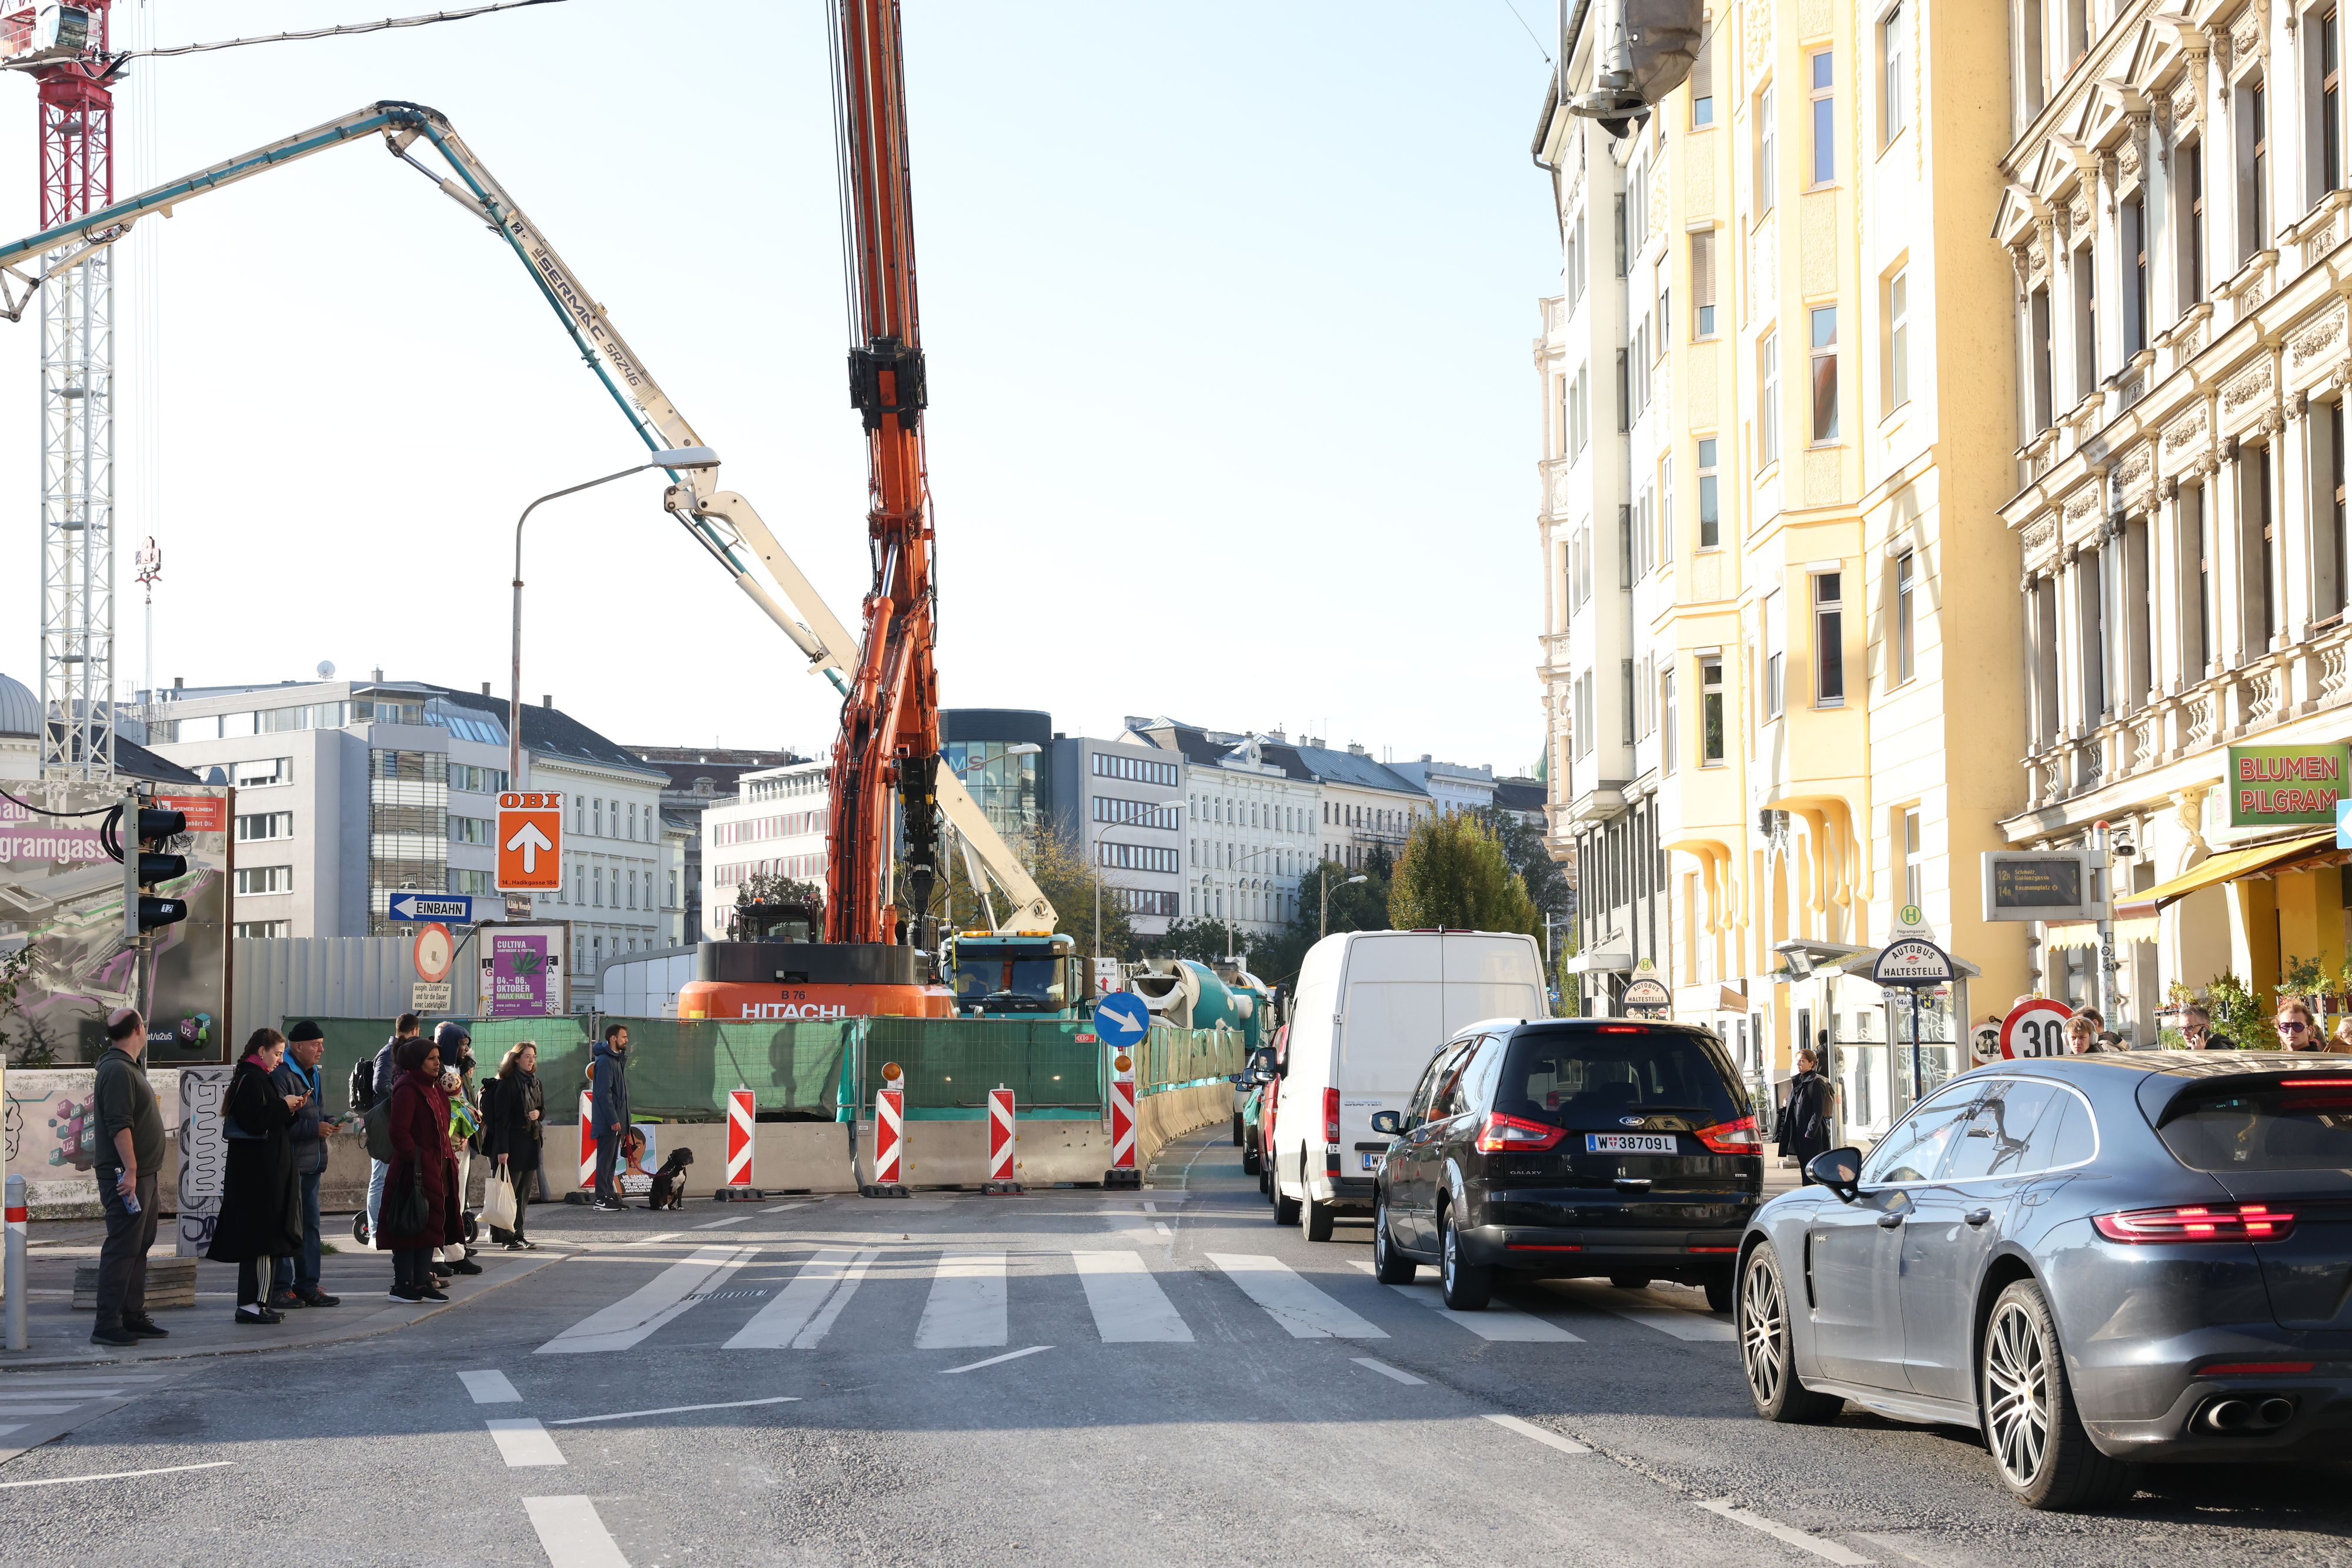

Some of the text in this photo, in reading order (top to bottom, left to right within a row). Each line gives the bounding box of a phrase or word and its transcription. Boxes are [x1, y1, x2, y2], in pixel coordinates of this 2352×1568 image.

[538, 257, 605, 341] SERMAC
[2239, 755, 2338, 782] BLUMEN
[500, 793, 560, 808] OBI
[2240, 788, 2339, 814] PILGRAM
[0, 837, 121, 864] gramgass
[1997, 870, 2010, 880] 12A
[2071, 869, 2076, 880] 1
[1997, 886, 2011, 897] 14A
[2072, 885, 2077, 895] 4
[416, 902, 463, 915] EINBAHN
[1906, 909, 1916, 922] H
[1892, 945, 1935, 959] AUTOBUS
[1884, 967, 1943, 977] HALTESTELLE
[496, 984, 530, 992] OKTOBER
[1633, 982, 1659, 992] AUTOBUS
[781, 991, 806, 999] B 76
[424, 1001, 447, 1010] Ladetätigkeit
[1924, 999, 1931, 1008] N
[742, 1003, 846, 1021] HITACHI
[203, 1019, 211, 1028] U5
[181, 1025, 191, 1037] U2
[2022, 1020, 2064, 1058] 30
[85, 1095, 94, 1105] U2
[58, 1102, 66, 1111] U2
[71, 1107, 81, 1116] U5
[84, 1115, 94, 1124] U5
[81, 1131, 94, 1142] U5
[63, 1141, 74, 1152] U2
[1598, 1136, 1608, 1149] W
[50, 1151, 59, 1160] U5
[1372, 1155, 1379, 1165] W
